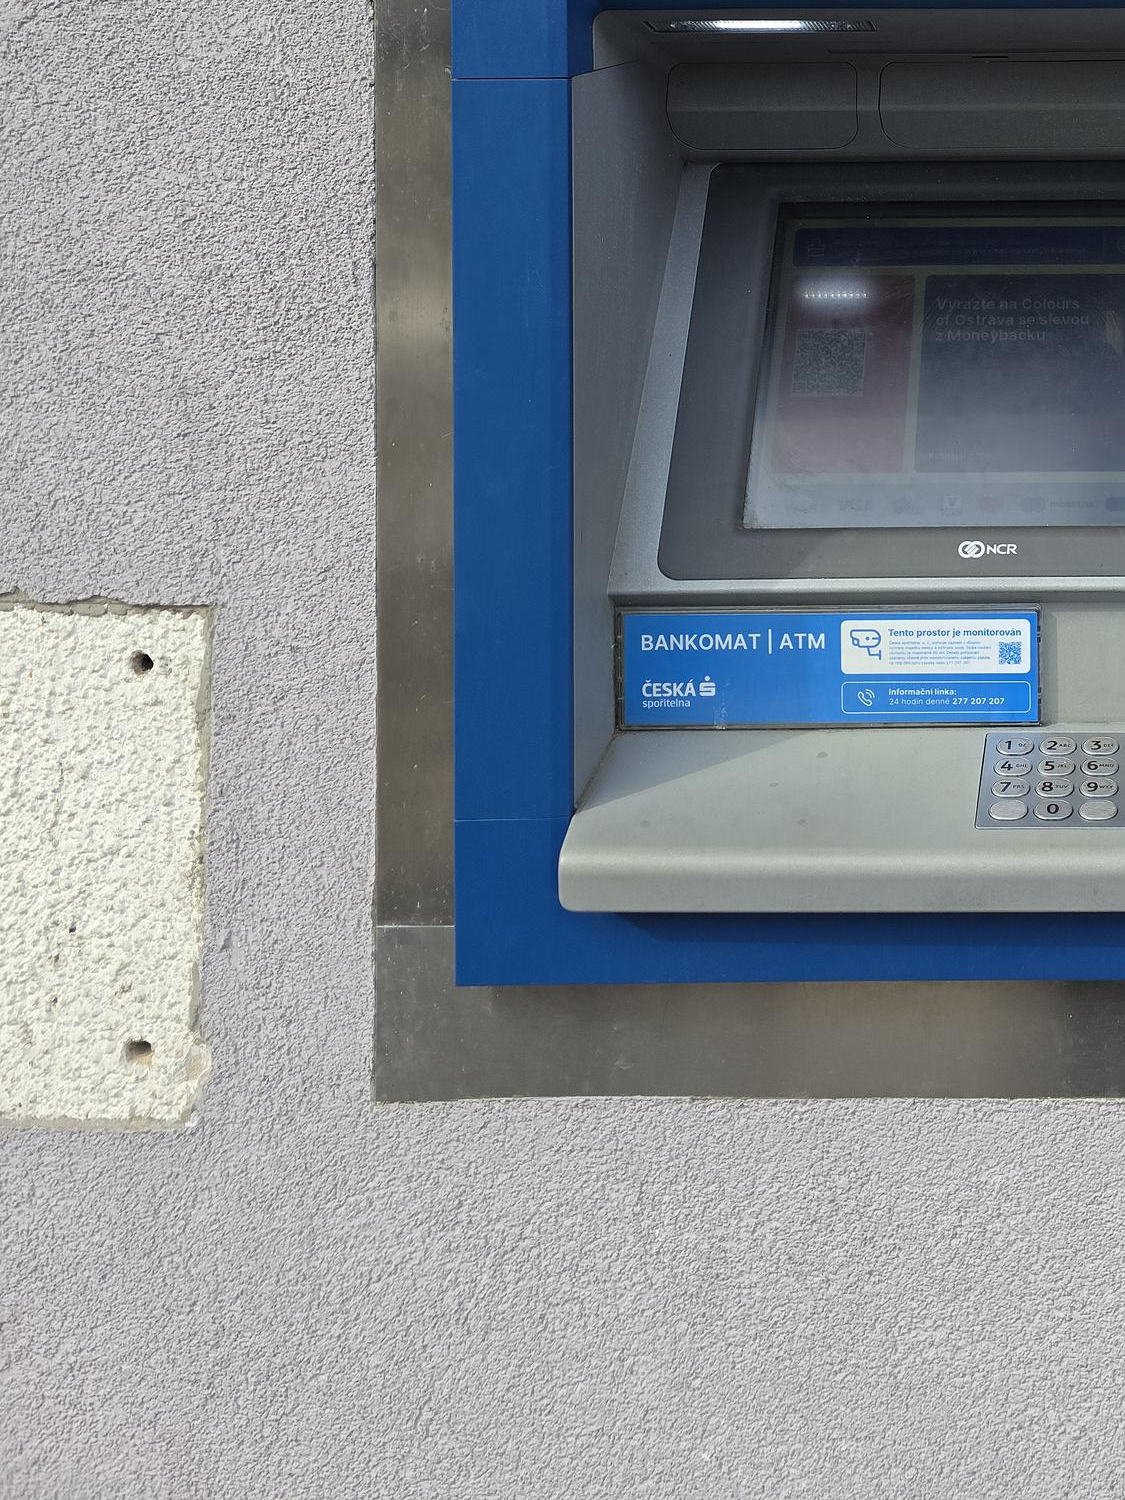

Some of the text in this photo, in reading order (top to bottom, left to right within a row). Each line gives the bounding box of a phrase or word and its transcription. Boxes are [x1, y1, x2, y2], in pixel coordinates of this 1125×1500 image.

[955, 314, 1014, 326] Ostrava
[946, 329, 1046, 344] Moneybacku
[986, 543, 1018, 555] NCR
[888, 628, 1022, 639] Tento prostor je monitorován
[641, 633, 826, 651] BANKOMAT ATM
[641, 678, 697, 698] ČESKÁ
[888, 688, 957, 696] Informační linka:
[642, 698, 691, 710] spořitelna
[889, 698, 899, 706] 24
[901, 698, 924, 706] hodin
[1004, 740, 1012, 750] 1
[1046, 740, 1058, 750] 2
[1090, 740, 1102, 750] 3
[1000, 760, 1014, 771] 4
[1044, 760, 1055, 771] 5
[1087, 760, 1099, 771] 6
[1000, 781, 1012, 792] 7
[1041, 781, 1054, 792] 8
[1086, 781, 1099, 792] 9
[1046, 803, 1060, 815] 0
